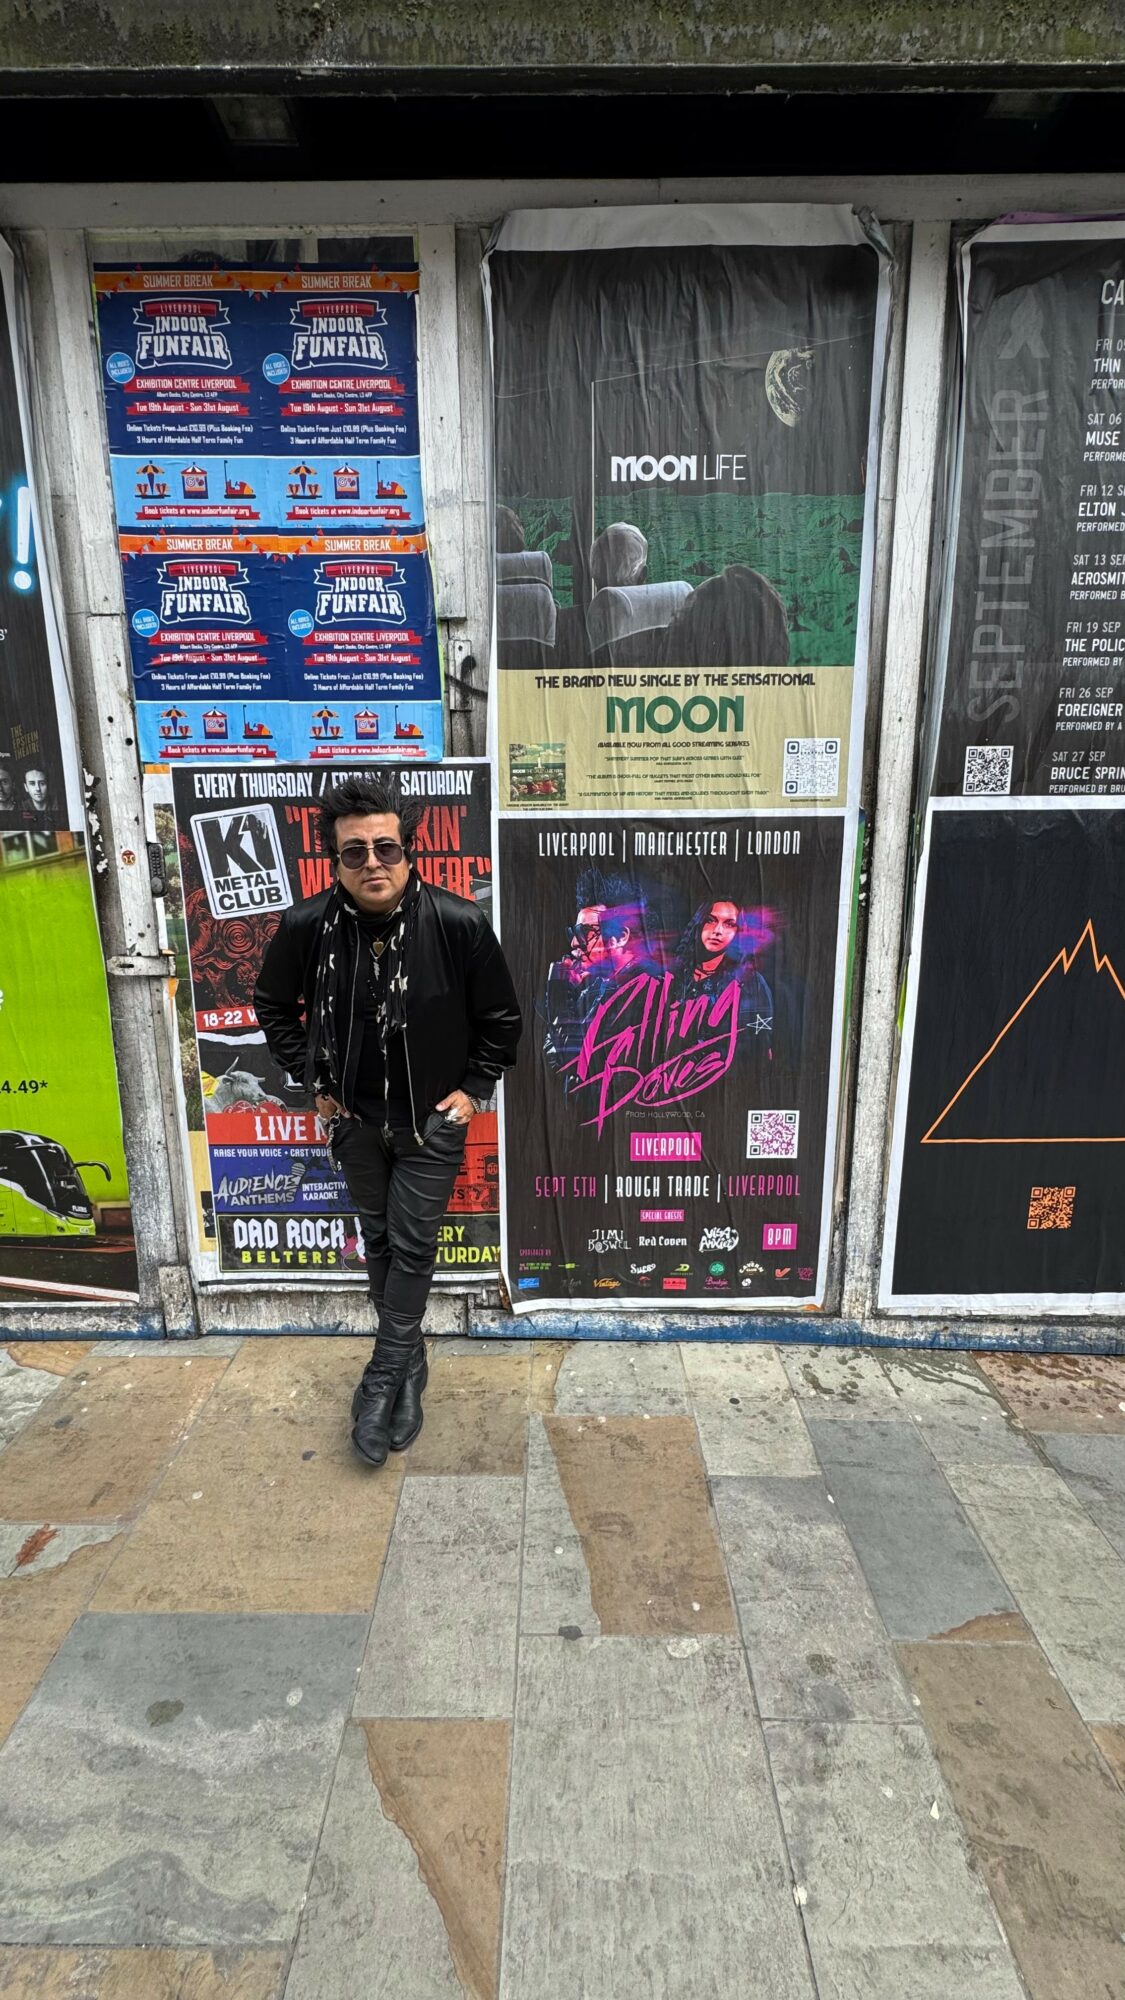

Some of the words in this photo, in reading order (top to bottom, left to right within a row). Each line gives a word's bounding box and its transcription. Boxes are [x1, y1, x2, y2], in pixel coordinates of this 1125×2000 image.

[143, 275, 181, 288] SUMMER
[184, 275, 213, 288] BREAK
[302, 276, 339, 288] SUMMER
[342, 275, 372, 288] BREAK
[160, 304, 201, 314] LIVERPOOL
[318, 305, 358, 314] LIVERPOOL
[155, 316, 208, 334] INDOOR
[312, 317, 365, 334] INDOOR
[140, 335, 228, 360] FUNFAIR
[296, 336, 384, 360] FUNFAIR
[1096, 338, 1112, 351] FRI
[1094, 358, 1121, 372] THIN
[136, 379, 172, 389] EXHIBITION
[174, 379, 199, 389] CENTRE
[201, 379, 237, 389] LIVERPOOL
[291, 380, 327, 390] EXHIBITION
[329, 380, 354, 390] CENTRE
[356, 380, 392, 390] LIVERPOOL
[1088, 413, 1104, 425] SAT
[1109, 413, 1122, 425] 06
[1086, 432, 1120, 446] MUSE
[611, 454, 698, 482] MOON
[704, 454, 747, 480] LIFE
[1080, 485, 1097, 496] FRI
[1102, 485, 1114, 496] 12
[1078, 502, 1116, 516] ELTON
[1076, 522, 1125, 532] PERFORMED
[166, 539, 203, 550] SUMMER
[205, 539, 233, 550] BREAK
[325, 540, 360, 552] SUMMER
[364, 540, 391, 550] BREAK
[967, 388, 1049, 724] SEPTEMBER
[1073, 554, 1090, 566] SAT
[1094, 554, 1106, 566] 13
[182, 565, 221, 574] LIVERPOOL
[340, 565, 379, 574] LIVERPOOL
[178, 576, 228, 592] INDOOR
[335, 577, 384, 592] INDOOR
[1070, 590, 1117, 600] PERFORMED
[164, 594, 247, 616] FUNFAIR
[320, 594, 402, 616] FUNFAIR
[1066, 622, 1082, 633] FRI
[1086, 622, 1098, 632] 19
[1102, 622, 1120, 632] SEP
[160, 632, 194, 641] EXHIBITION
[196, 632, 220, 641] CENTRE
[222, 632, 256, 641] LIVERPOOL
[314, 632, 349, 642] EXHIBITION
[351, 632, 374, 642] CENTRE
[376, 632, 410, 642] LIVERPOOL
[1065, 638, 1087, 652] THE
[313, 654, 324, 662] Tue
[326, 654, 338, 662] 19th
[339, 654, 359, 663] August
[365, 654, 376, 662] Sun
[378, 654, 390, 662] 31st
[390, 654, 410, 663] August
[1062, 657, 1110, 666] PERFORMED
[1113, 657, 1123, 666] BY
[535, 676, 560, 688] THE
[562, 675, 605, 688] BRAND
[608, 674, 636, 686] NEW
[640, 674, 681, 687] SINGLE
[684, 674, 700, 686] BY
[704, 674, 728, 686] THE
[732, 673, 815, 686] SENSATIONAL
[1059, 688, 1075, 698] FRI
[1079, 688, 1090, 698] 26
[1096, 688, 1113, 698] SEP
[606, 696, 744, 734] MOON
[1058, 704, 1123, 716] FOREIGNER
[1056, 722, 1102, 730] PERFORMED
[1105, 722, 1114, 730] BY
[1052, 752, 1068, 762] SAT
[1072, 752, 1084, 762] 27
[1089, 752, 1106, 762] SEP
[1051, 766, 1090, 780] BRUCE
[194, 773, 236, 798] EVERY
[240, 772, 313, 798] THURSDAY
[400, 770, 474, 796] SATURDAY
[1049, 784, 1096, 793] PERFORMED
[1099, 784, 1107, 793] BY
[539, 832, 614, 856] LIVERPOOL
[634, 831, 727, 856] MANCHESTER
[748, 830, 800, 855] LONDON
[214, 872, 278, 893] METAL
[218, 886, 282, 911] CLUB
[203, 1010, 242, 1027] 18-22
[626, 1110, 646, 1118] FROM
[696, 1110, 706, 1118] CA
[255, 1116, 308, 1141] LIVE
[214, 1148, 236, 1158] RAISE
[238, 1148, 260, 1157] YOUR
[260, 1148, 282, 1157] VOICE
[290, 1148, 310, 1157] CAST
[635, 1138, 696, 1156] LIVERPOOL
[213, 1168, 296, 1203] AUDIENCE
[302, 1181, 348, 1192] INTERACTIV
[535, 1176, 566, 1198] SEPT
[574, 1176, 596, 1198] 5TH
[616, 1176, 660, 1198] ROUGH
[668, 1176, 710, 1197] TRADE
[728, 1175, 800, 1197] LIVERPOOL
[230, 1192, 294, 1206] ANTHEMS
[302, 1192, 338, 1200] KARAOKE
[642, 1210, 662, 1220] SPECIAL
[664, 1210, 682, 1220] GUESTS
[234, 1218, 278, 1249] DAD
[286, 1218, 346, 1249] ROCK
[592, 1228, 624, 1241] JIMI
[768, 1228, 792, 1246] 8PM
[639, 1236, 656, 1246] Red
[658, 1236, 688, 1246] Coven
[242, 1250, 336, 1264] BELTERS
